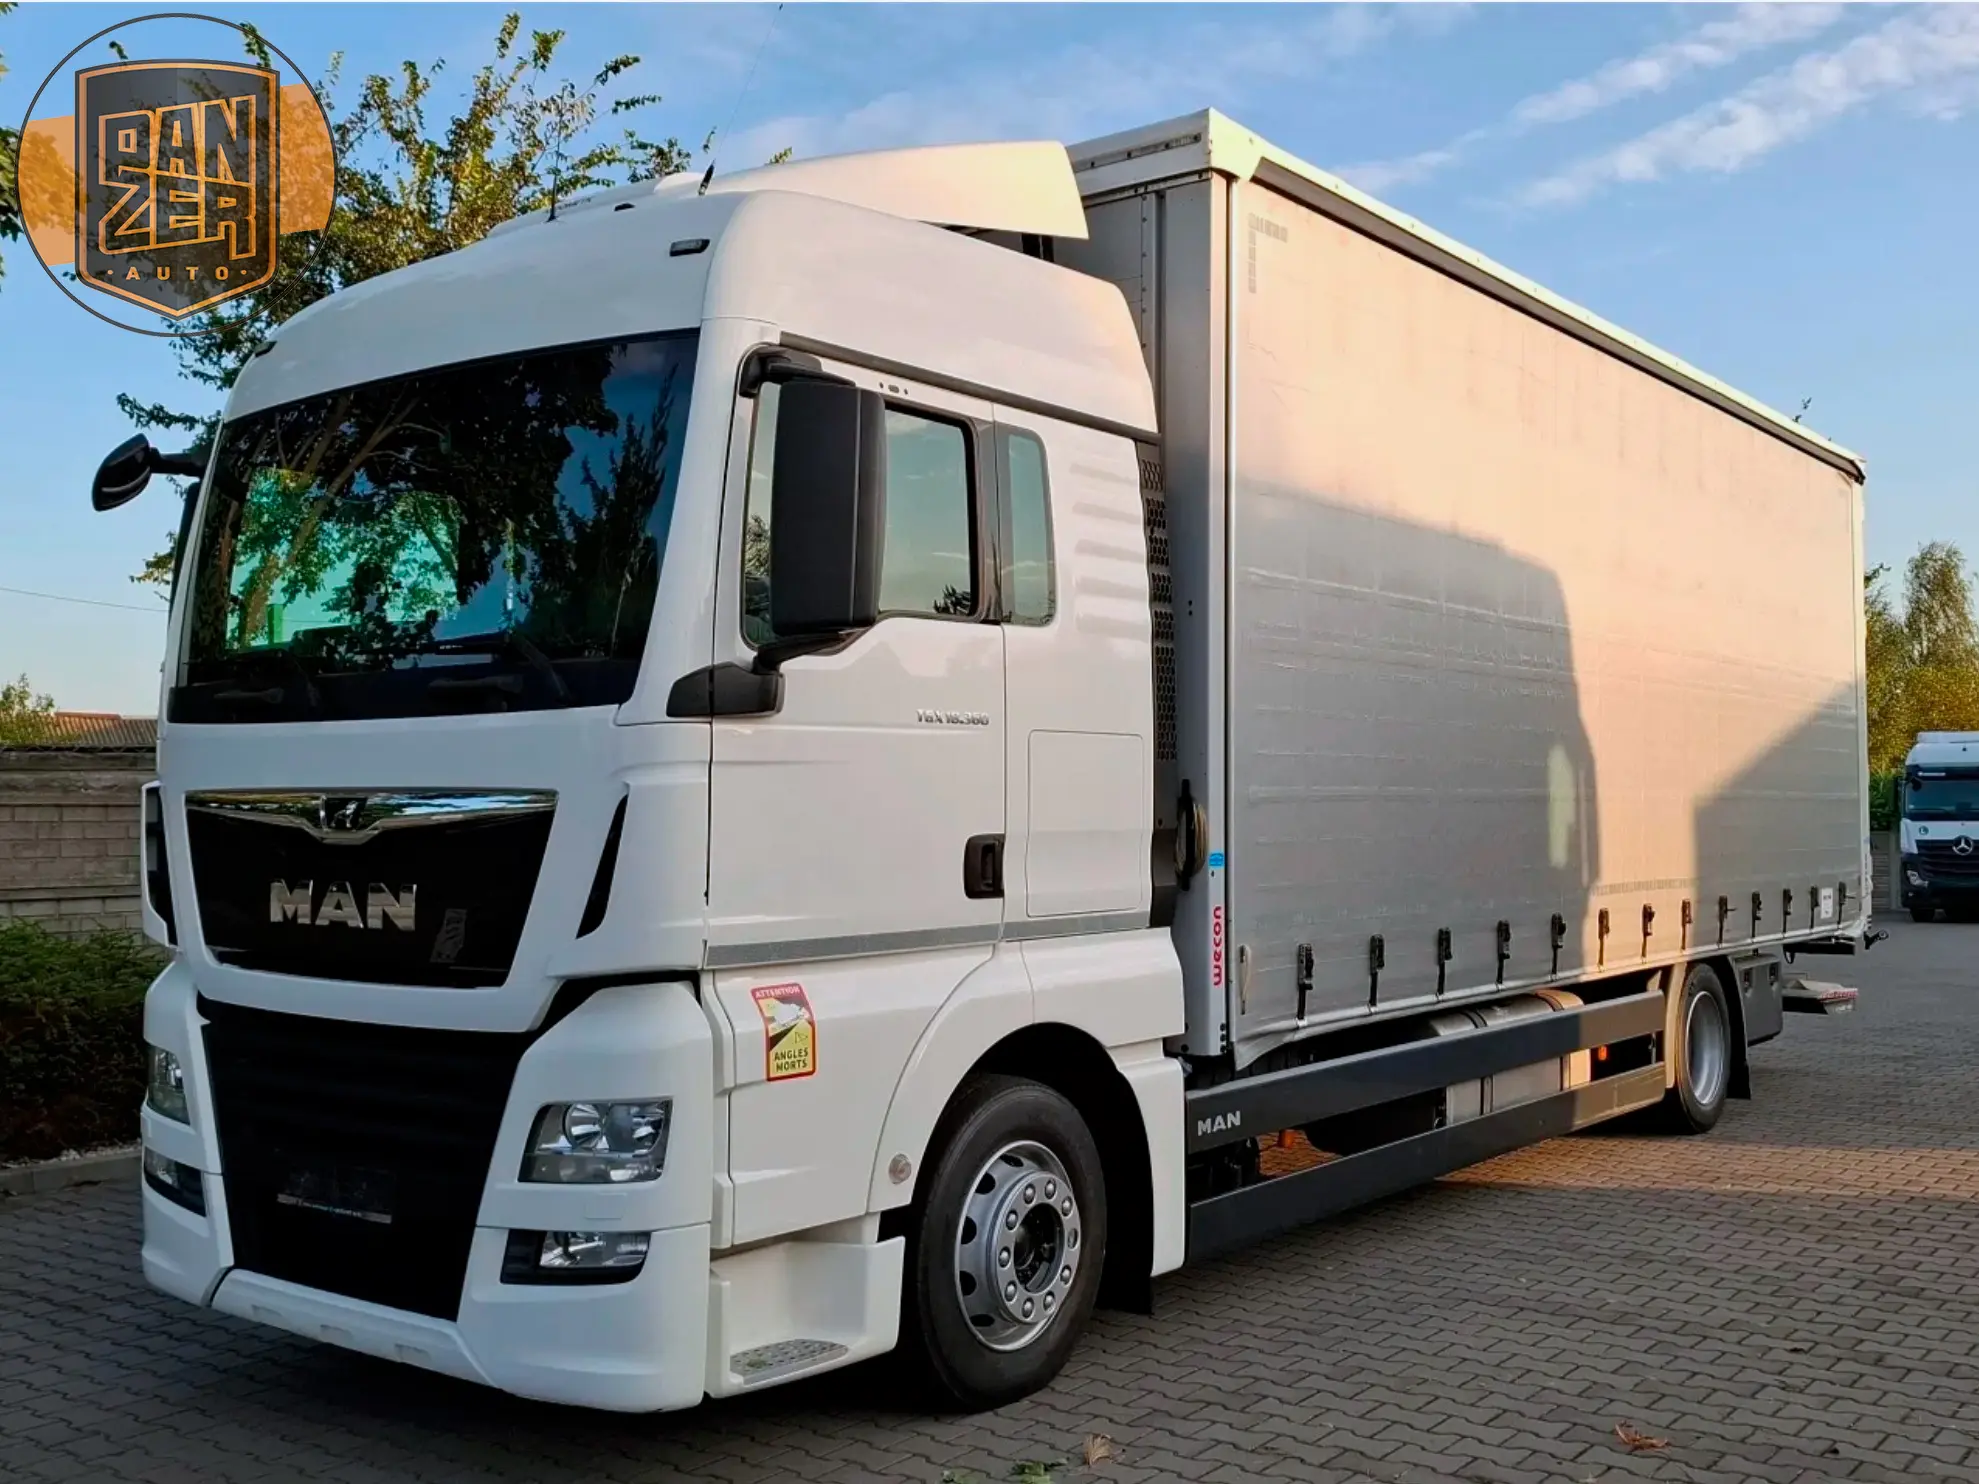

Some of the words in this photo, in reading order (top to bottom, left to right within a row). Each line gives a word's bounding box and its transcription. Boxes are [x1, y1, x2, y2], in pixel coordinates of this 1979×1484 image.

[915, 708, 943, 724] TGX
[270, 878, 417, 931] MAN
[1213, 905, 1222, 986] wecon
[755, 986, 801, 999] ATTENTION
[774, 1047, 808, 1061] ANGLES
[776, 1059, 808, 1072] MORTS
[1197, 1110, 1241, 1136] MAN
